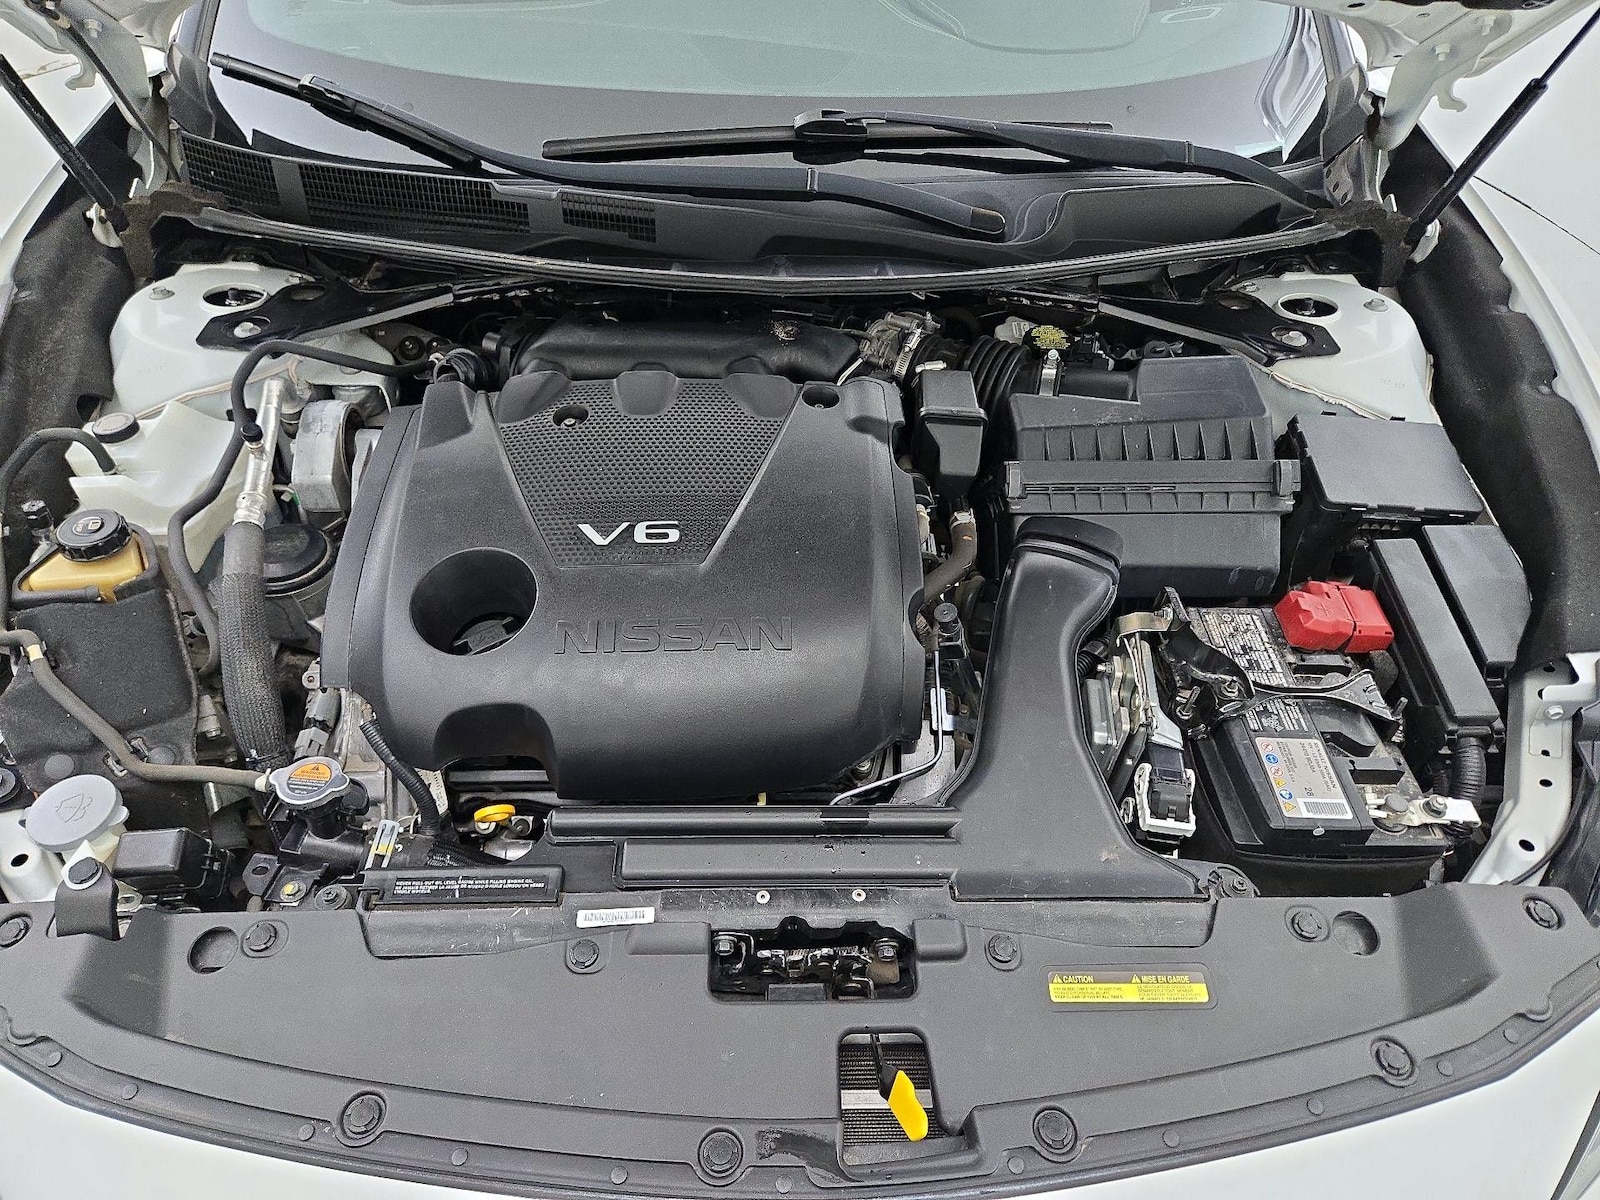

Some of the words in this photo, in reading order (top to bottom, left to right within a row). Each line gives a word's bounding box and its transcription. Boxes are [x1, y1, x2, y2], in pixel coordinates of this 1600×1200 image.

[577, 520, 681, 546] V6
[554, 616, 793, 654] NISSAN
[1324, 765, 1337, 789] NISSAN
[1304, 786, 1315, 797] 28
[1062, 975, 1094, 984] CAUTION
[1141, 975, 1158, 984] MISE
[1157, 975, 1167, 984] EN
[1167, 975, 1190, 984] GARDE
